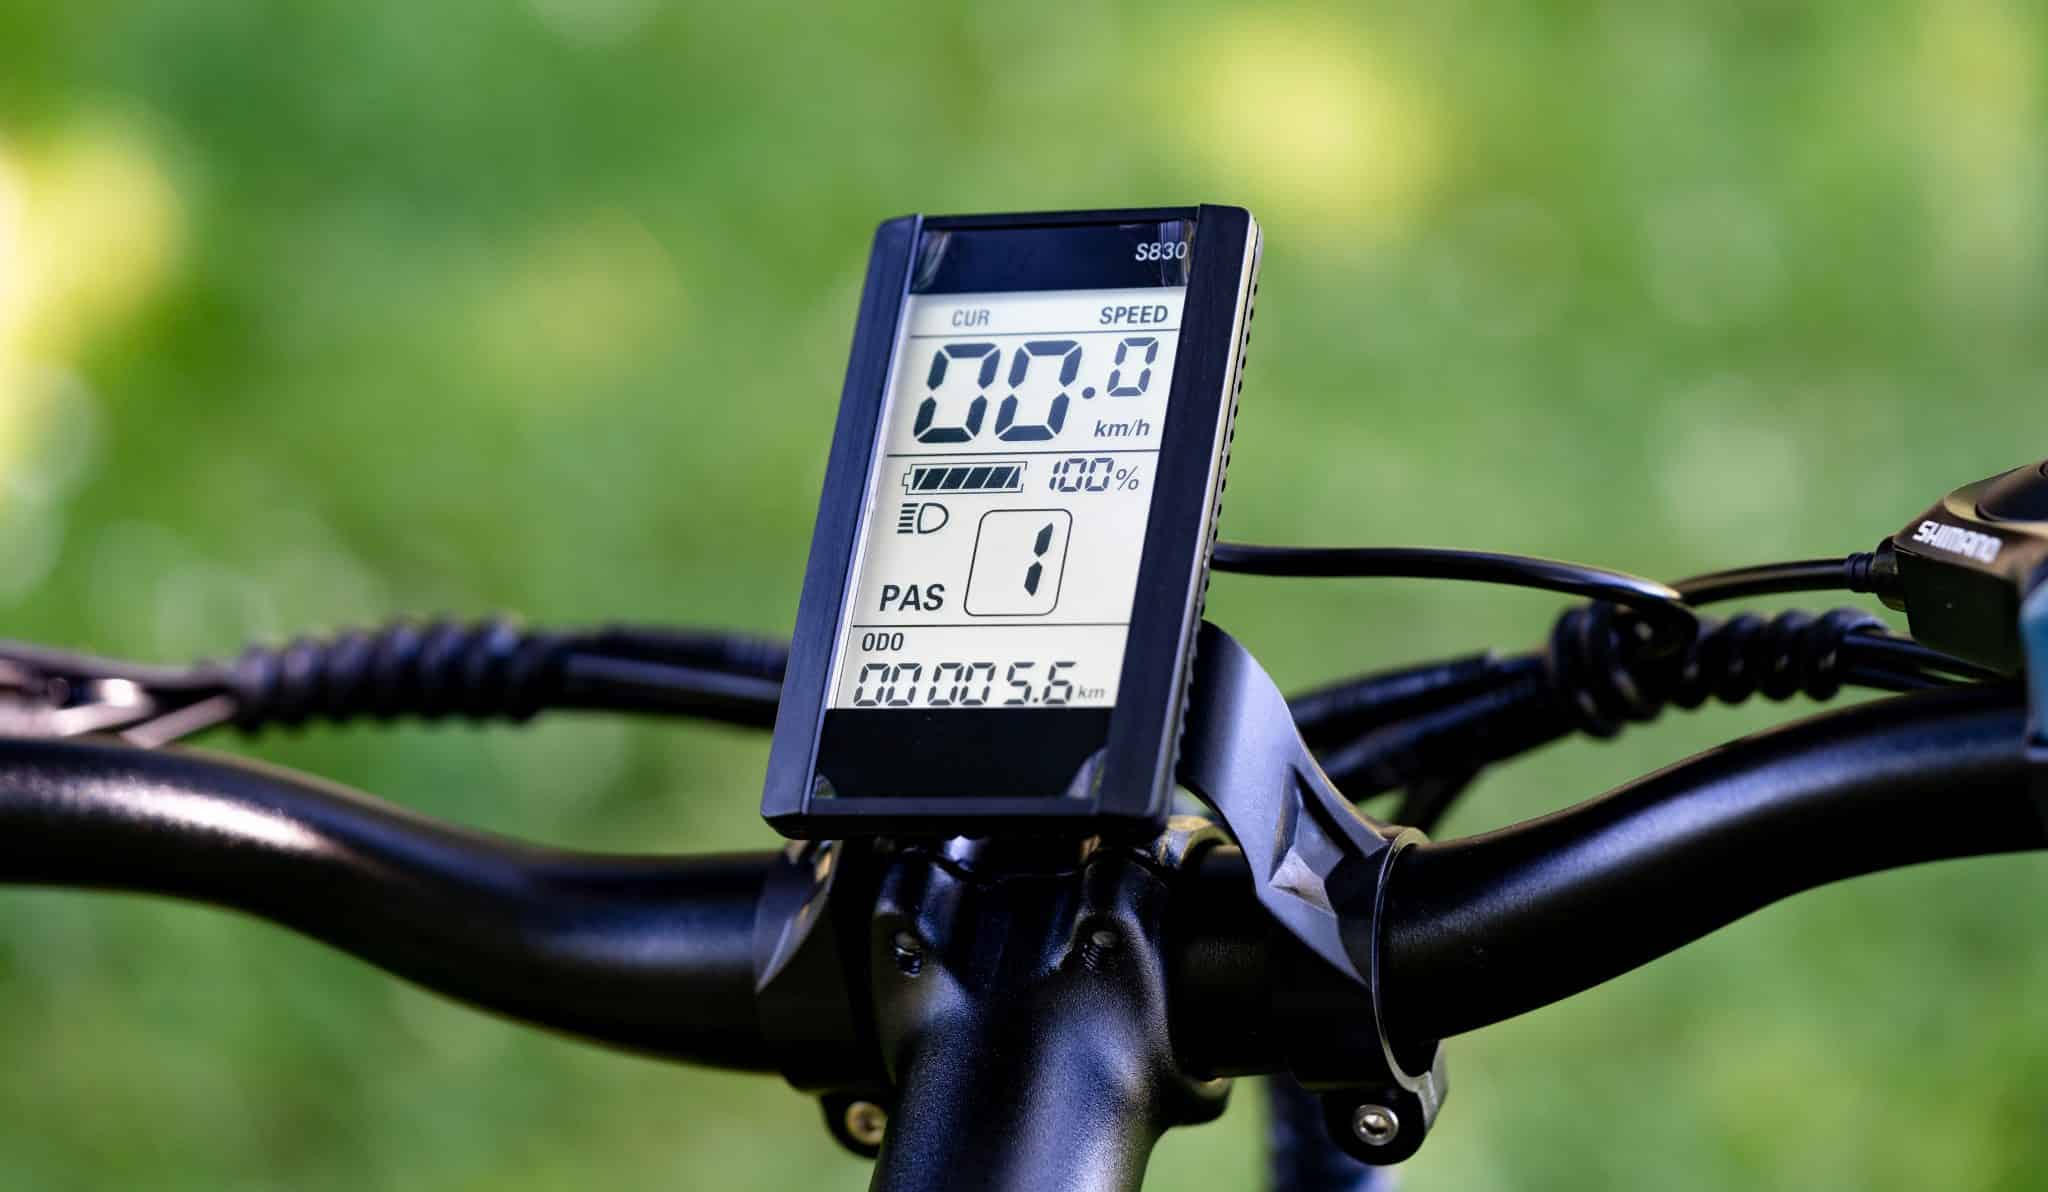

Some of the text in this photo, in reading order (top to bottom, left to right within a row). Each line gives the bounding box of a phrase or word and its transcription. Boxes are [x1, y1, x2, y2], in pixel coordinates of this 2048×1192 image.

[1135, 241, 1188, 262] S830
[951, 309, 991, 328] CUR
[1099, 305, 1168, 325] SPEED
[913, 336, 1159, 444] 00.0
[1093, 418, 1150, 438] km/h
[1048, 457, 1139, 493] 100%
[1912, 520, 2003, 564] SHIMANO
[1023, 522, 1054, 597] 1
[879, 583, 945, 612] PAS
[861, 632, 904, 652] ODO
[1077, 685, 1106, 699] km
